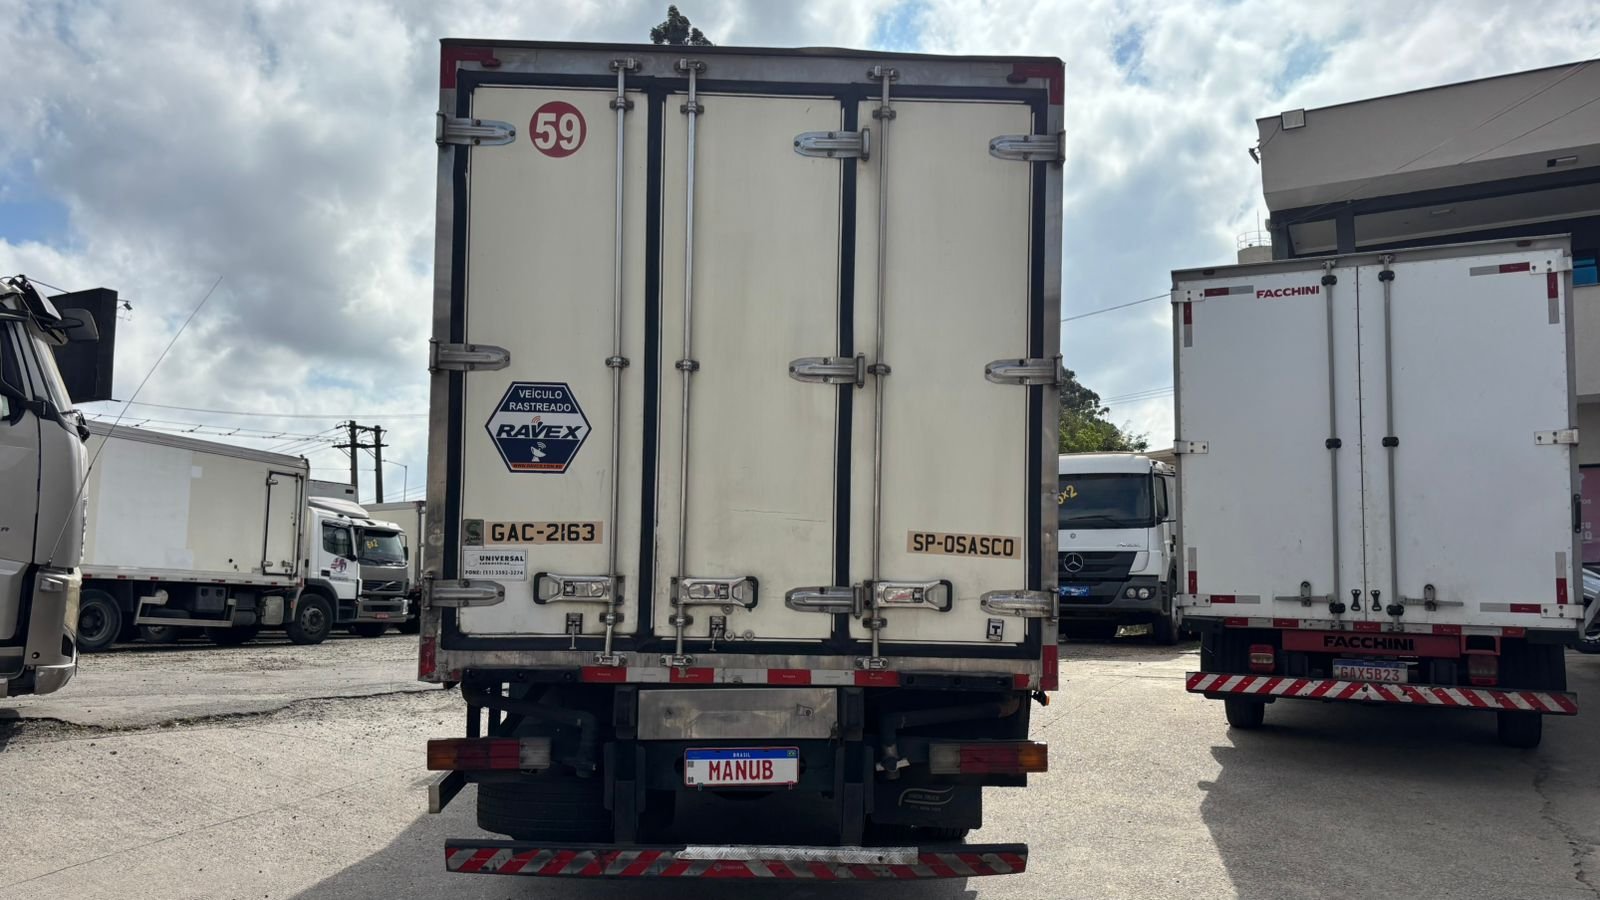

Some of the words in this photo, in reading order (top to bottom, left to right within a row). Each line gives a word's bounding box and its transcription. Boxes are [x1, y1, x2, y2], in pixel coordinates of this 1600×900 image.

[534, 112, 581, 151] 59
[1256, 285, 1320, 299] FACCHINI
[518, 387, 563, 399] VEÍCULO
[509, 402, 572, 412] RASTREADO
[496, 421, 584, 439] RAVEX
[492, 523, 595, 542] GAC-2163
[913, 533, 1014, 557] SP-OSASCO
[1323, 635, 1415, 651] FACCHINI
[1340, 666, 1400, 682] GAX5B23
[708, 759, 774, 781] MANUB
